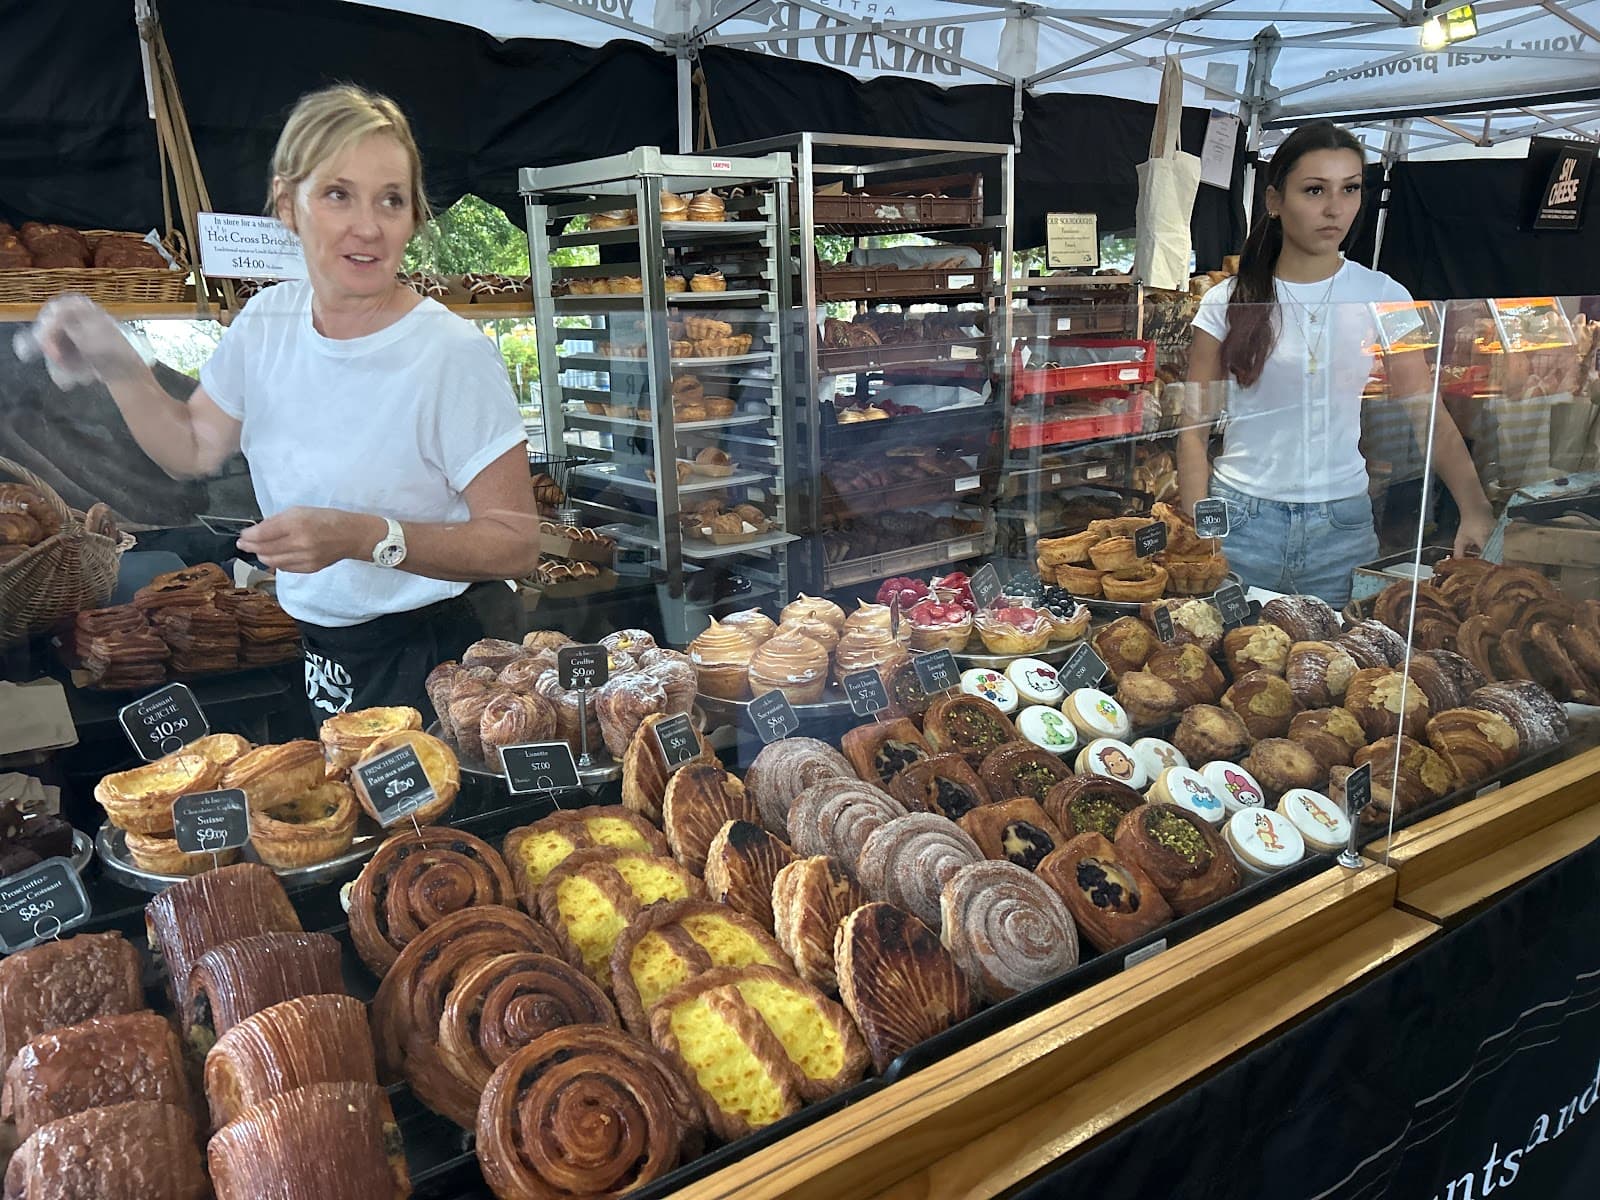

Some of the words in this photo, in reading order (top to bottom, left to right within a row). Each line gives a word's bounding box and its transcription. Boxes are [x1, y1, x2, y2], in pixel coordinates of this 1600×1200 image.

[1547, 178, 1580, 207] CHEESE
[223, 218, 240, 226] store
[241, 218, 251, 227] for
[207, 230, 229, 242] Hot
[230, 231, 260, 244] Cross
[232, 256, 265, 269] $14.00
[572, 667, 595, 678] $9.00
[138, 696, 174, 715] Croissant
[143, 704, 180, 725] QUICHE
[149, 717, 189, 743] $10.50
[364, 760, 389, 776] FRENCH
[367, 775, 385, 786] Pain
[384, 769, 397, 778] aux
[197, 815, 225, 825] Suisse
[196, 827, 228, 842] $9.00
[0, 878, 43, 900] Prosciutto
[0, 898, 28, 914] Cheese
[26, 880, 62, 900] Croissant
[19, 900, 55, 921] $8.50
[1433, 1143, 1524, 1200] nts
